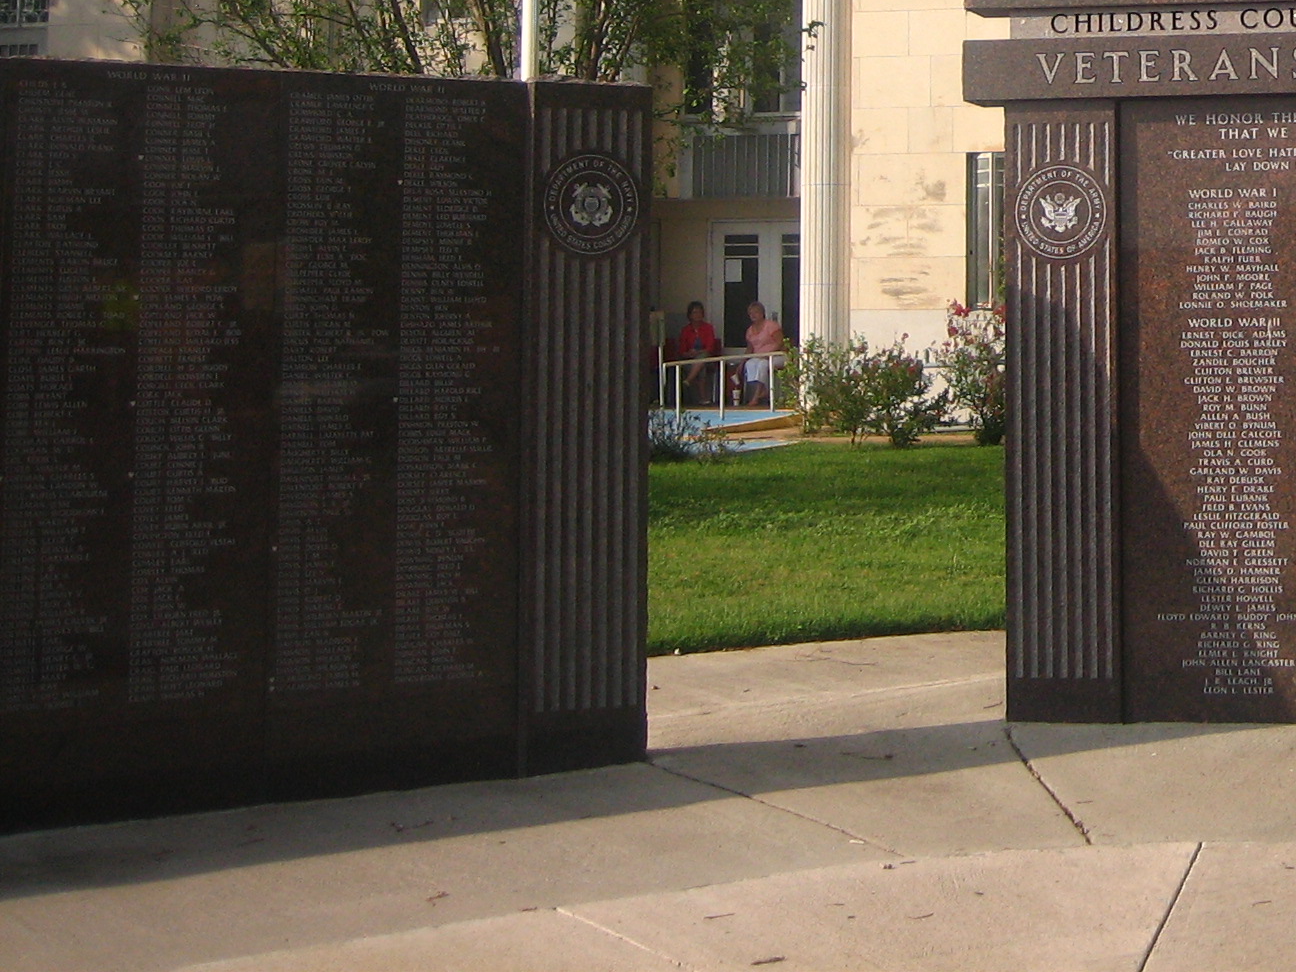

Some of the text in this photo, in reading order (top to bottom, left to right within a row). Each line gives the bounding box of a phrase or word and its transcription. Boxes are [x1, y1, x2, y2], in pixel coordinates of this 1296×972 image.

[1050, 9, 1219, 35] CHILDRESS
[1175, 114, 1197, 126] WE
[1205, 113, 1264, 125] HONOR
[1218, 128, 1259, 140] THAT
[1266, 127, 1289, 138] WE
[1231, 148, 1263, 158] LOVE
[1225, 161, 1247, 172] LAY
[1252, 160, 1290, 171] DOWN
[1020, 170, 1102, 211] DEPARTMENT OF THE ARMY
[1188, 187, 1277, 199] WORLD WAR I
[1188, 317, 1281, 328] WORLD WAR II
